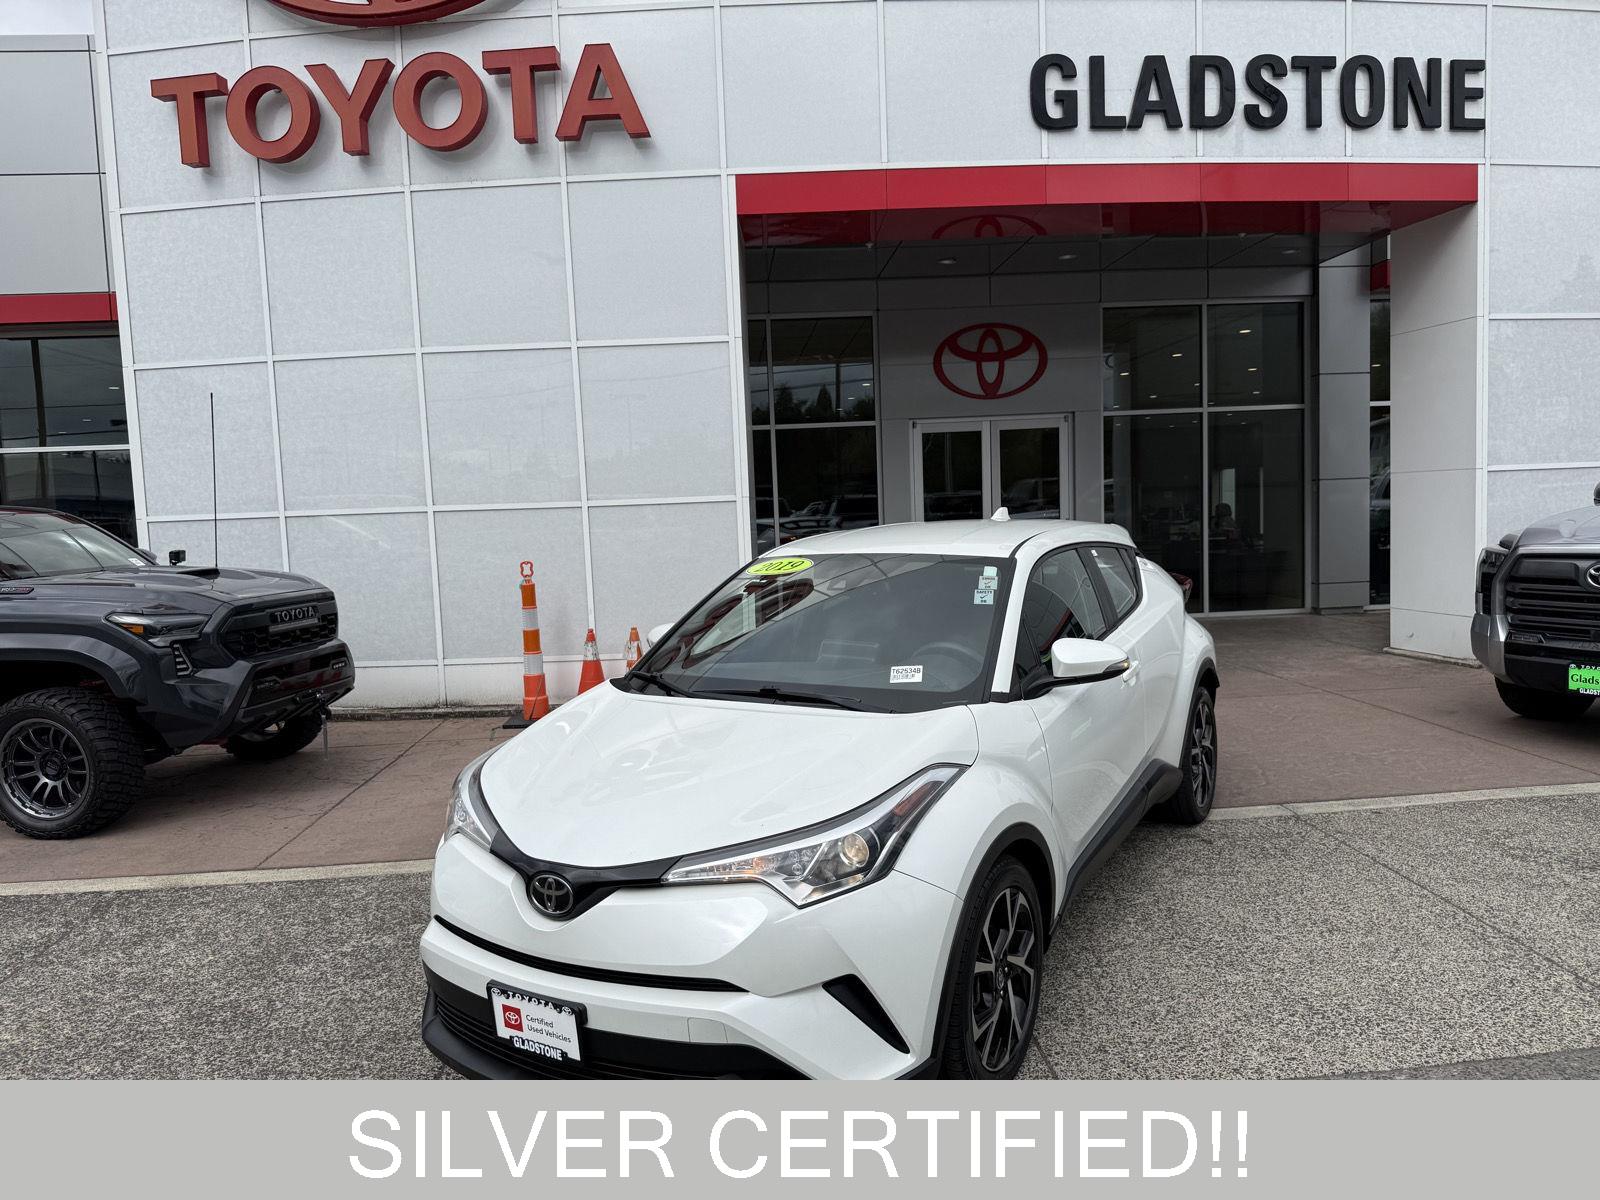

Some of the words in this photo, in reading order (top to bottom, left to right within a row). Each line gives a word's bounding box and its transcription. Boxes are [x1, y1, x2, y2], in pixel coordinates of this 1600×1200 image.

[1030, 53, 1486, 131] GLADSTONE
[150, 43, 651, 168] TOYOTA
[754, 560, 804, 572] 2019
[275, 606, 316, 623] TOYOTA
[1570, 673, 1600, 685] Glads
[507, 991, 554, 1009] TOYOTA
[525, 1014, 554, 1028] Certified
[527, 1024, 543, 1035] Used
[544, 1028, 572, 1043] Vehicles
[513, 1036, 563, 1061] GLADSTONE
